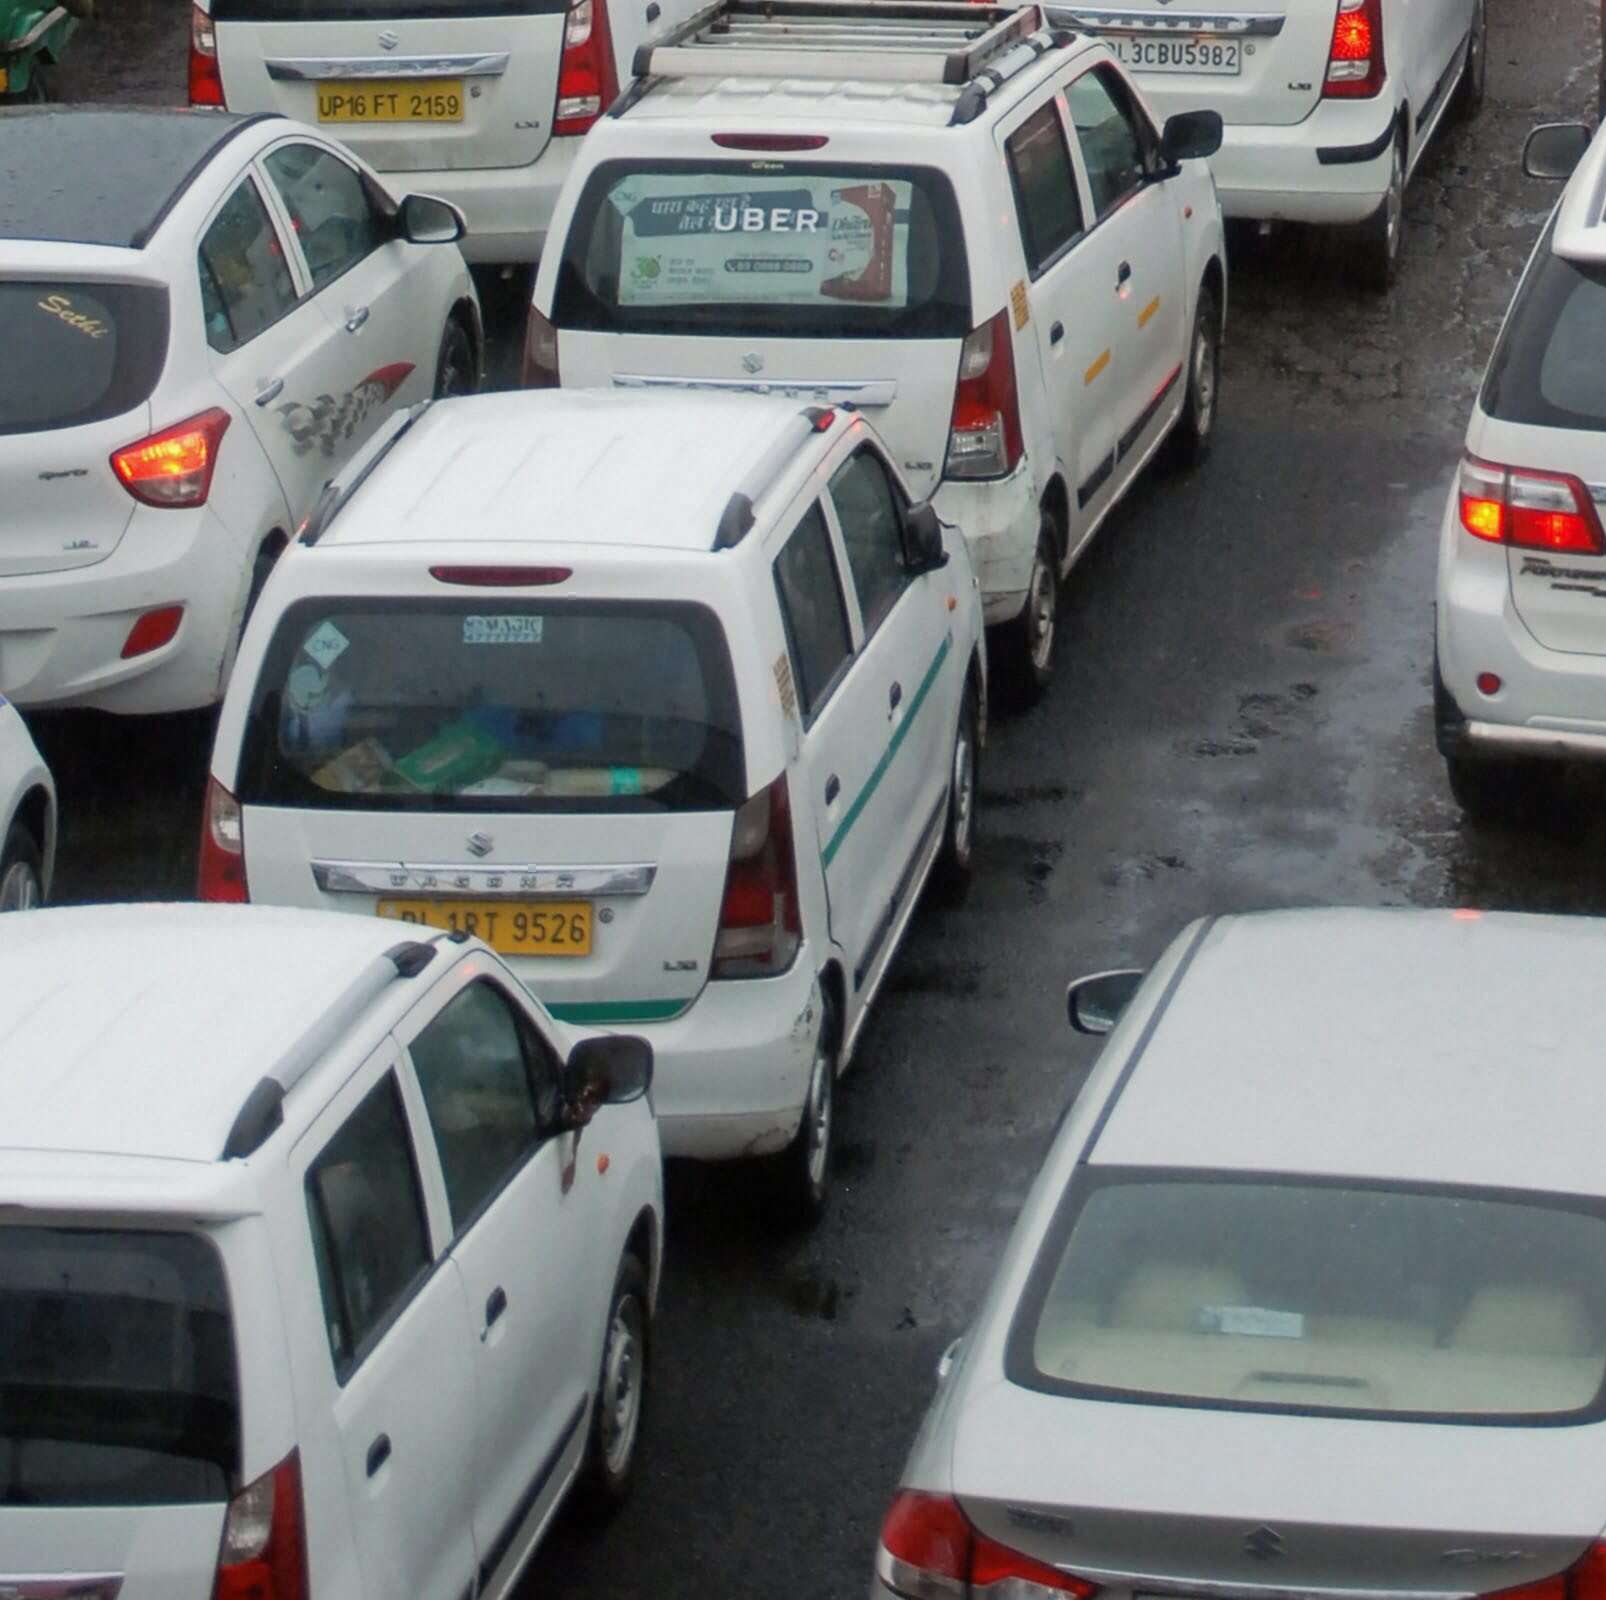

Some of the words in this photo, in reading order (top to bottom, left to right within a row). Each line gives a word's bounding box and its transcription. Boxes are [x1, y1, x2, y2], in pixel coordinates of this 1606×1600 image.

[319, 94, 366, 117] UP16
[373, 94, 399, 116] FT
[410, 94, 460, 117] 2159
[714, 207, 819, 233] UBER
[38, 295, 108, 338] Sethi
[512, 912, 586, 944] 9526
